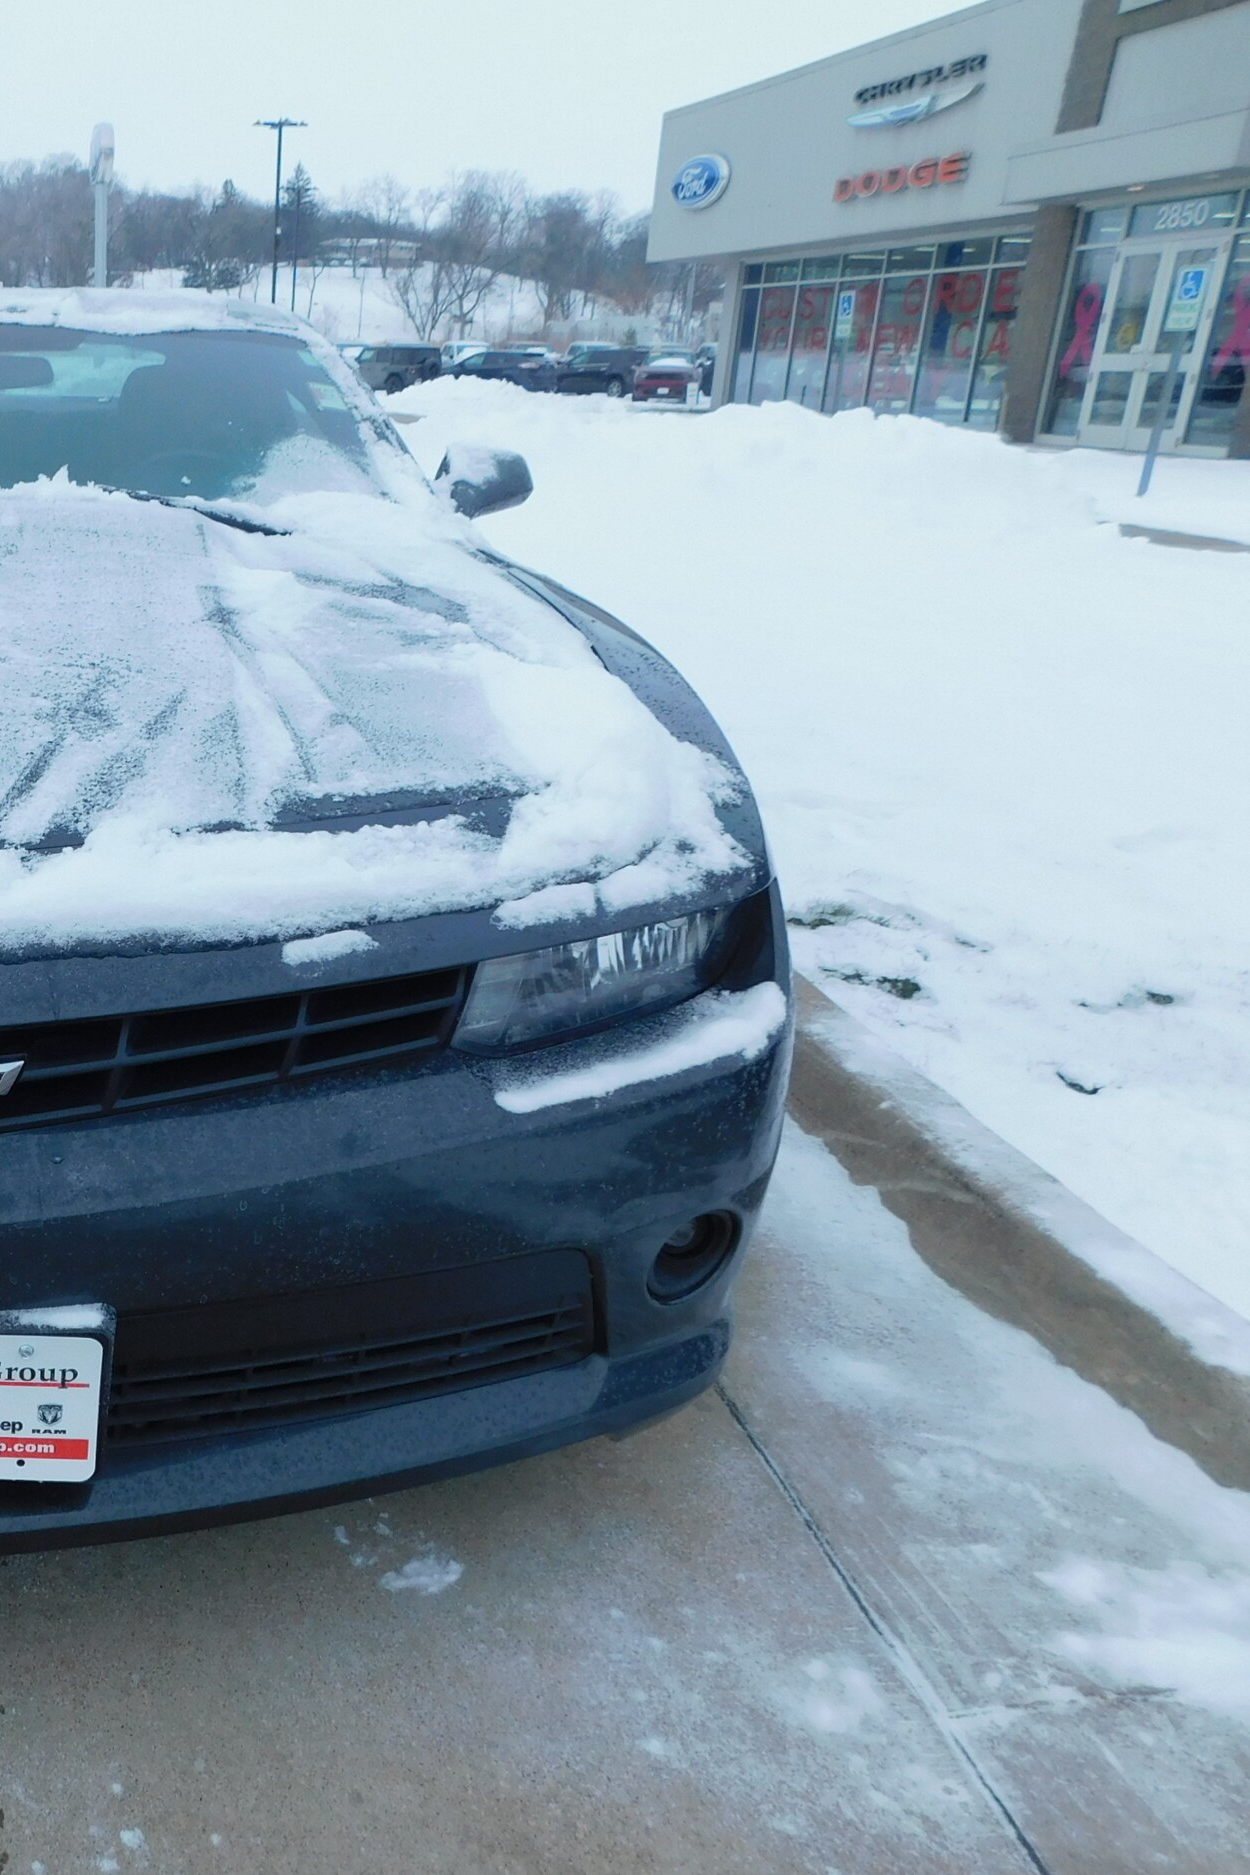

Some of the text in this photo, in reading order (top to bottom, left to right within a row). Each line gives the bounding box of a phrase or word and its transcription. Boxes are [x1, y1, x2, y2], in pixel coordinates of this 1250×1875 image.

[854, 54, 988, 104] CHRYSLER
[677, 166, 709, 200] Ford
[833, 151, 971, 202] DODGE
[1153, 200, 1210, 231] 2850
[764, 269, 1019, 320] CUSTM ORDE
[952, 318, 1012, 358] CA
